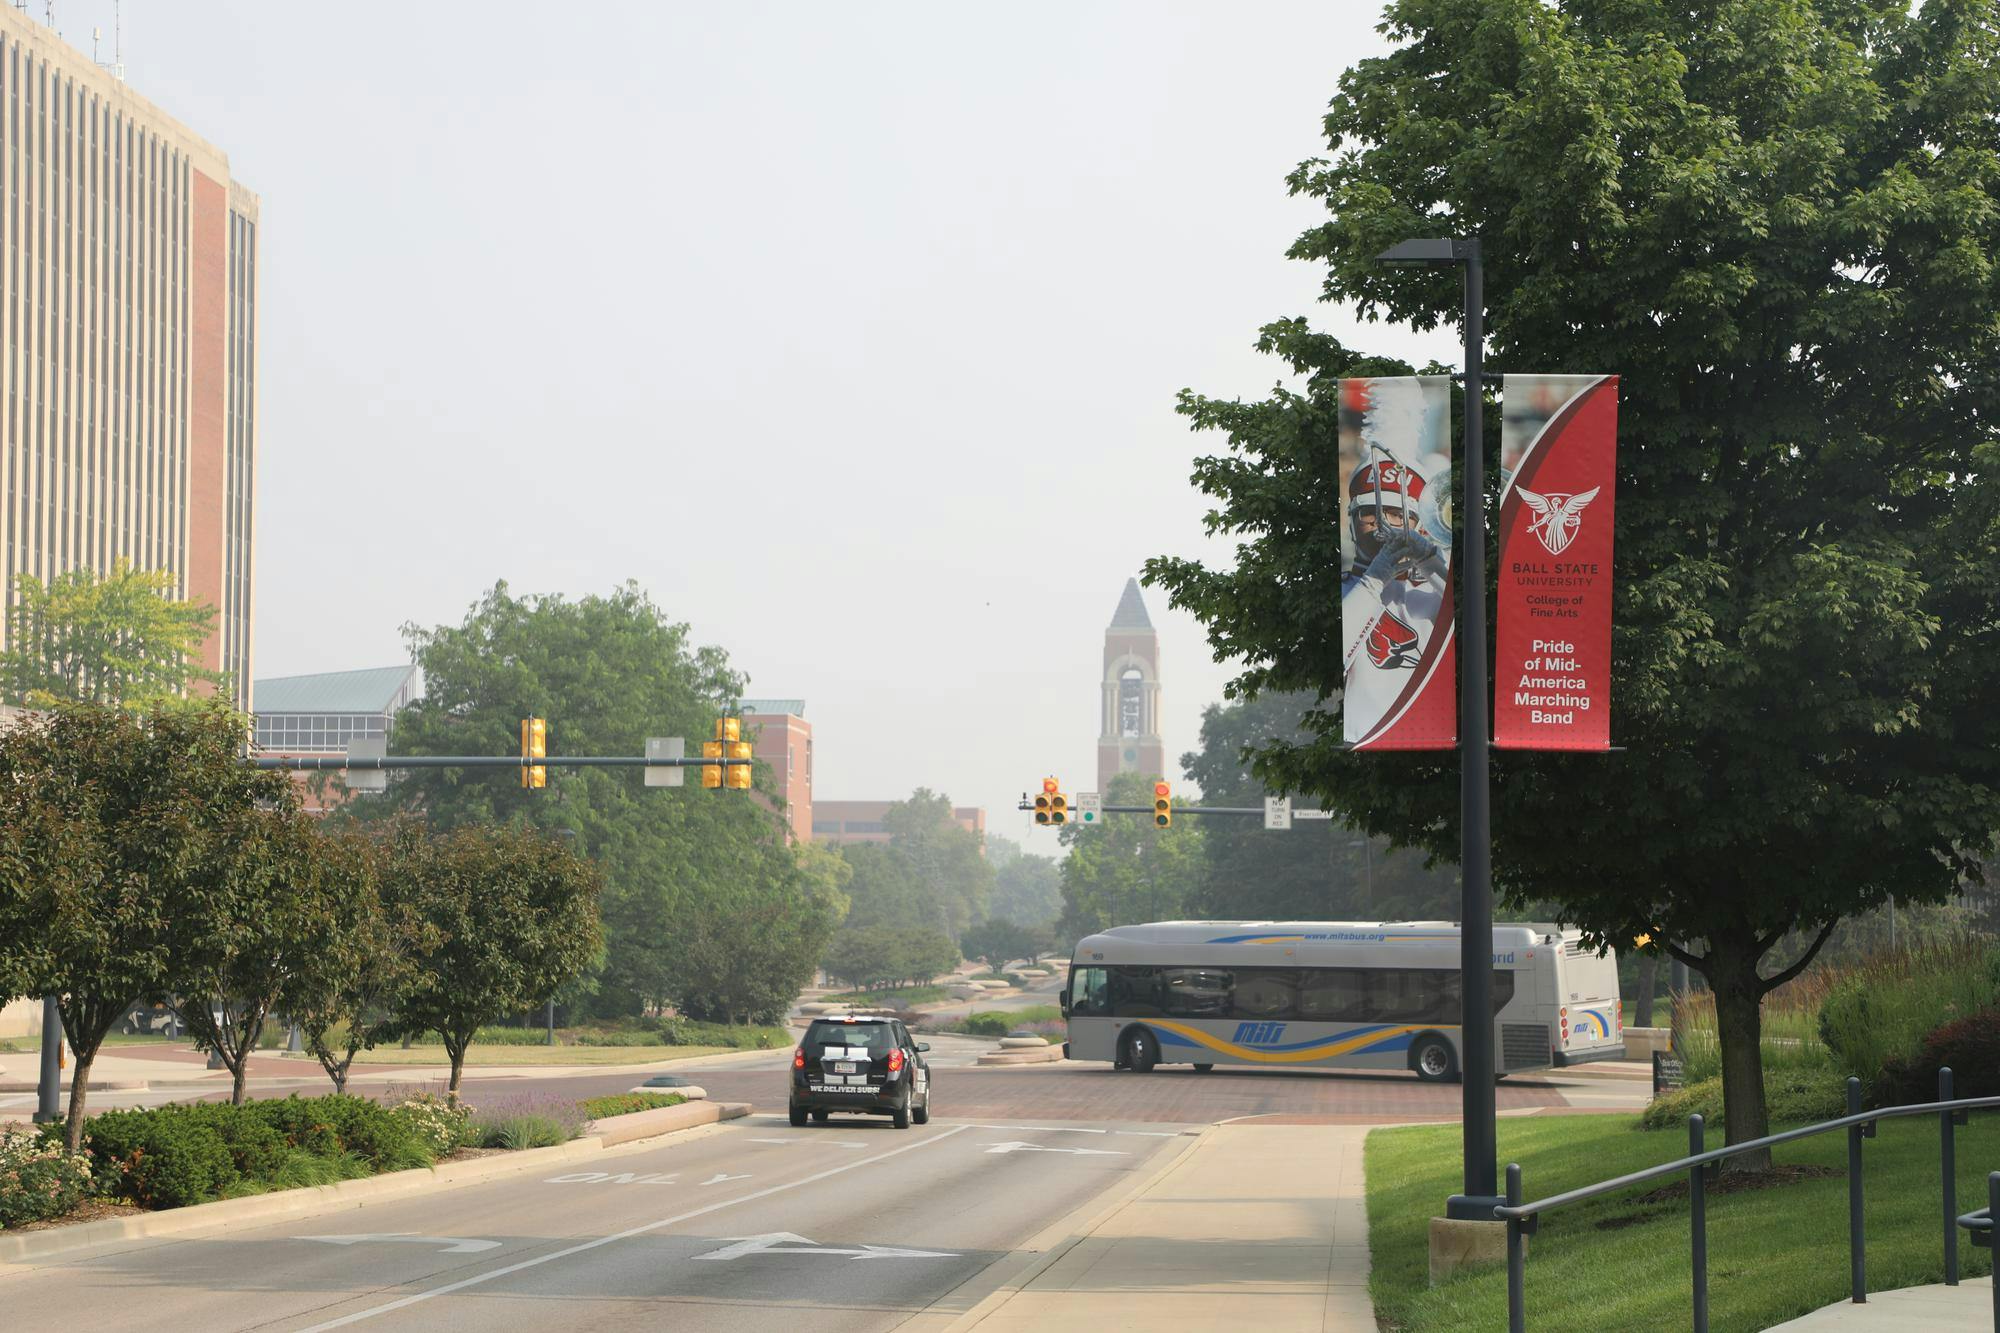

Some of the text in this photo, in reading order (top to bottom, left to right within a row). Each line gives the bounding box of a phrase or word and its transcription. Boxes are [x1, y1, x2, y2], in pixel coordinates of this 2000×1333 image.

[1513, 563, 1599, 575] BALL STATE
[1517, 577, 1593, 587] UNIVERSITY
[1526, 595, 1583, 607] College of
[1530, 608, 1579, 618] Fine Arts
[1532, 639, 1575, 653] Pride
[1524, 658, 1582, 671] of Mid-
[1518, 674, 1586, 689] America
[1514, 692, 1590, 710] Marching
[1531, 710, 1573, 724] Band
[1304, 932, 1386, 942] www.mitsbus.org
